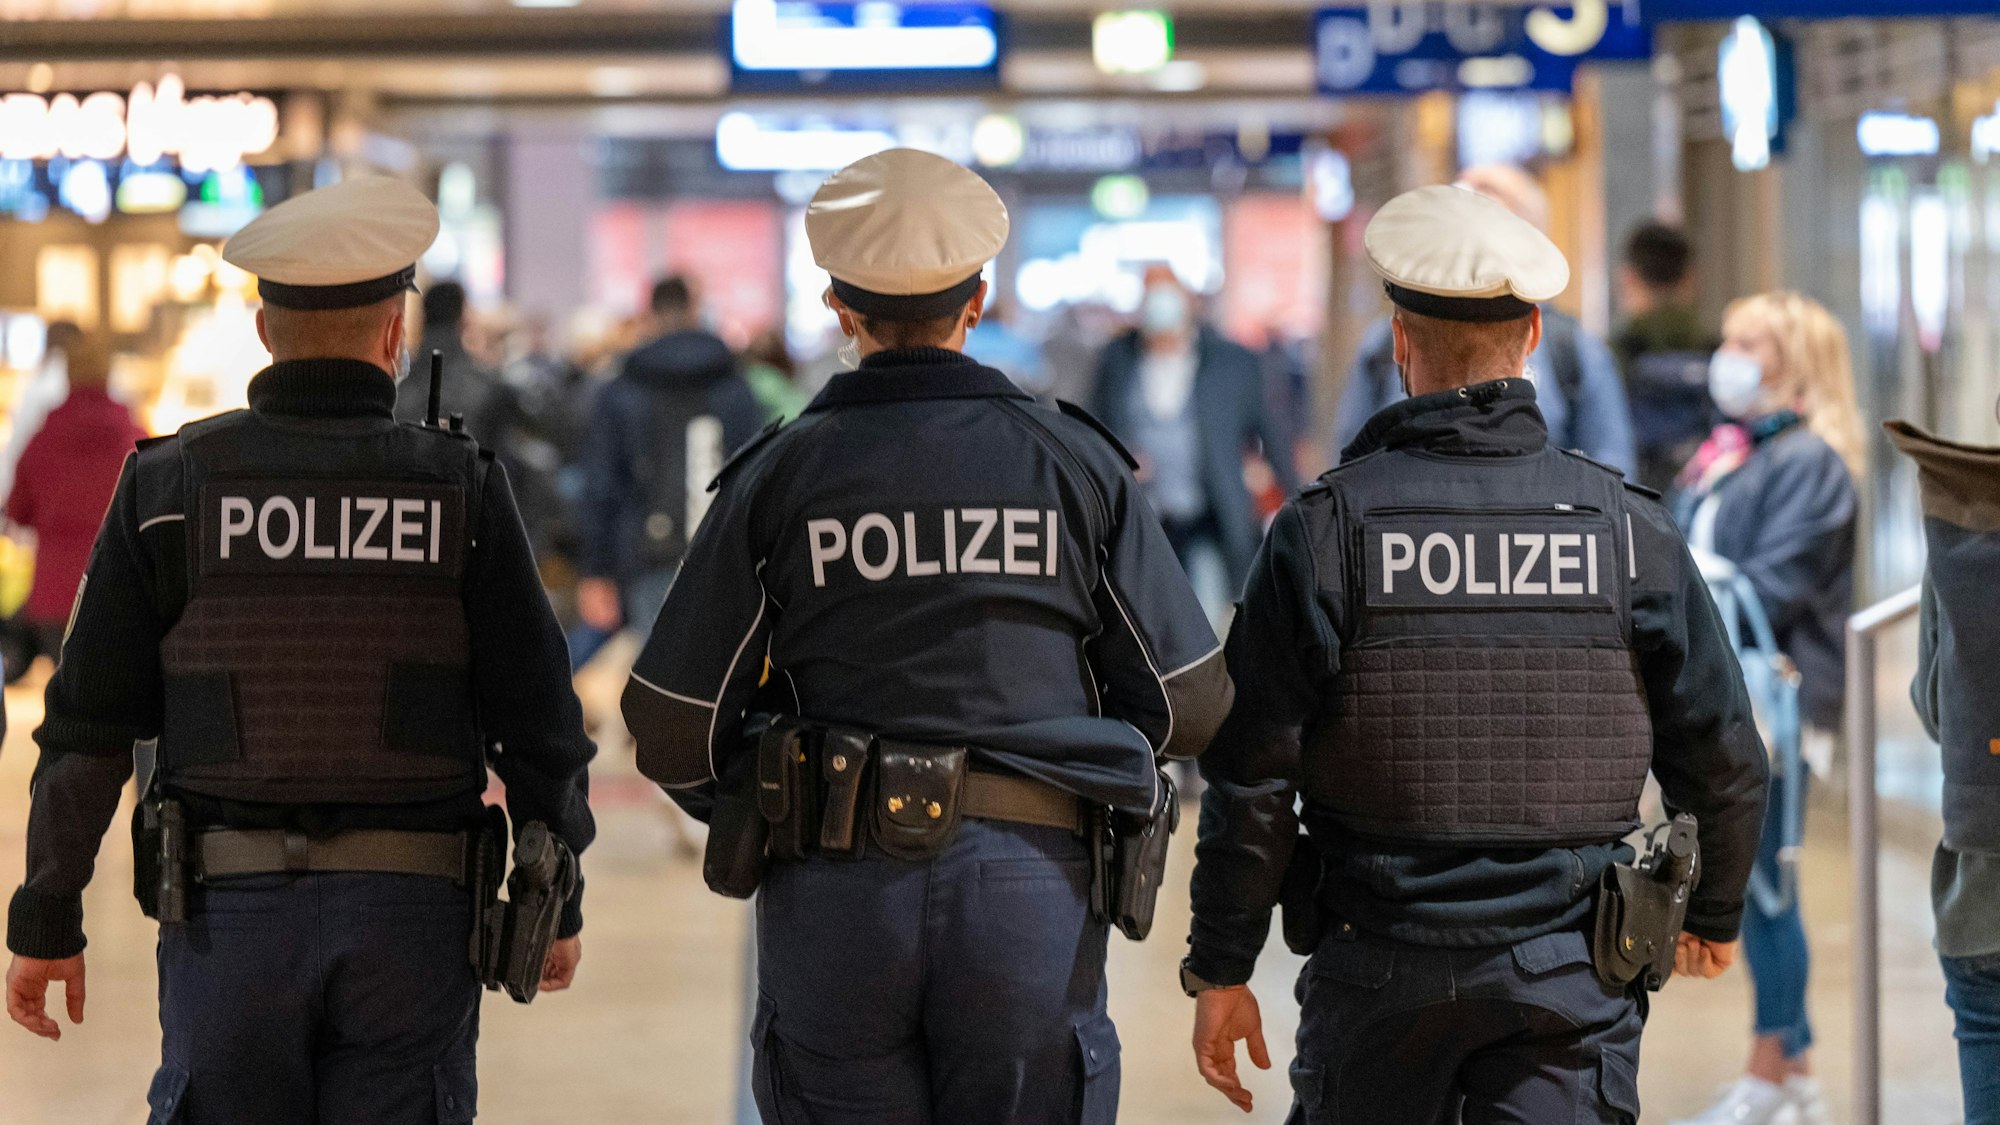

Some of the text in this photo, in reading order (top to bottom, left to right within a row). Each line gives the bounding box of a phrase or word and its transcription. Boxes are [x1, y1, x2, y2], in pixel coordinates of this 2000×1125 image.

[219, 495, 442, 561] POLIZEI
[806, 507, 1059, 588] POLIZEI
[1380, 531, 1600, 596] POLIZEI
